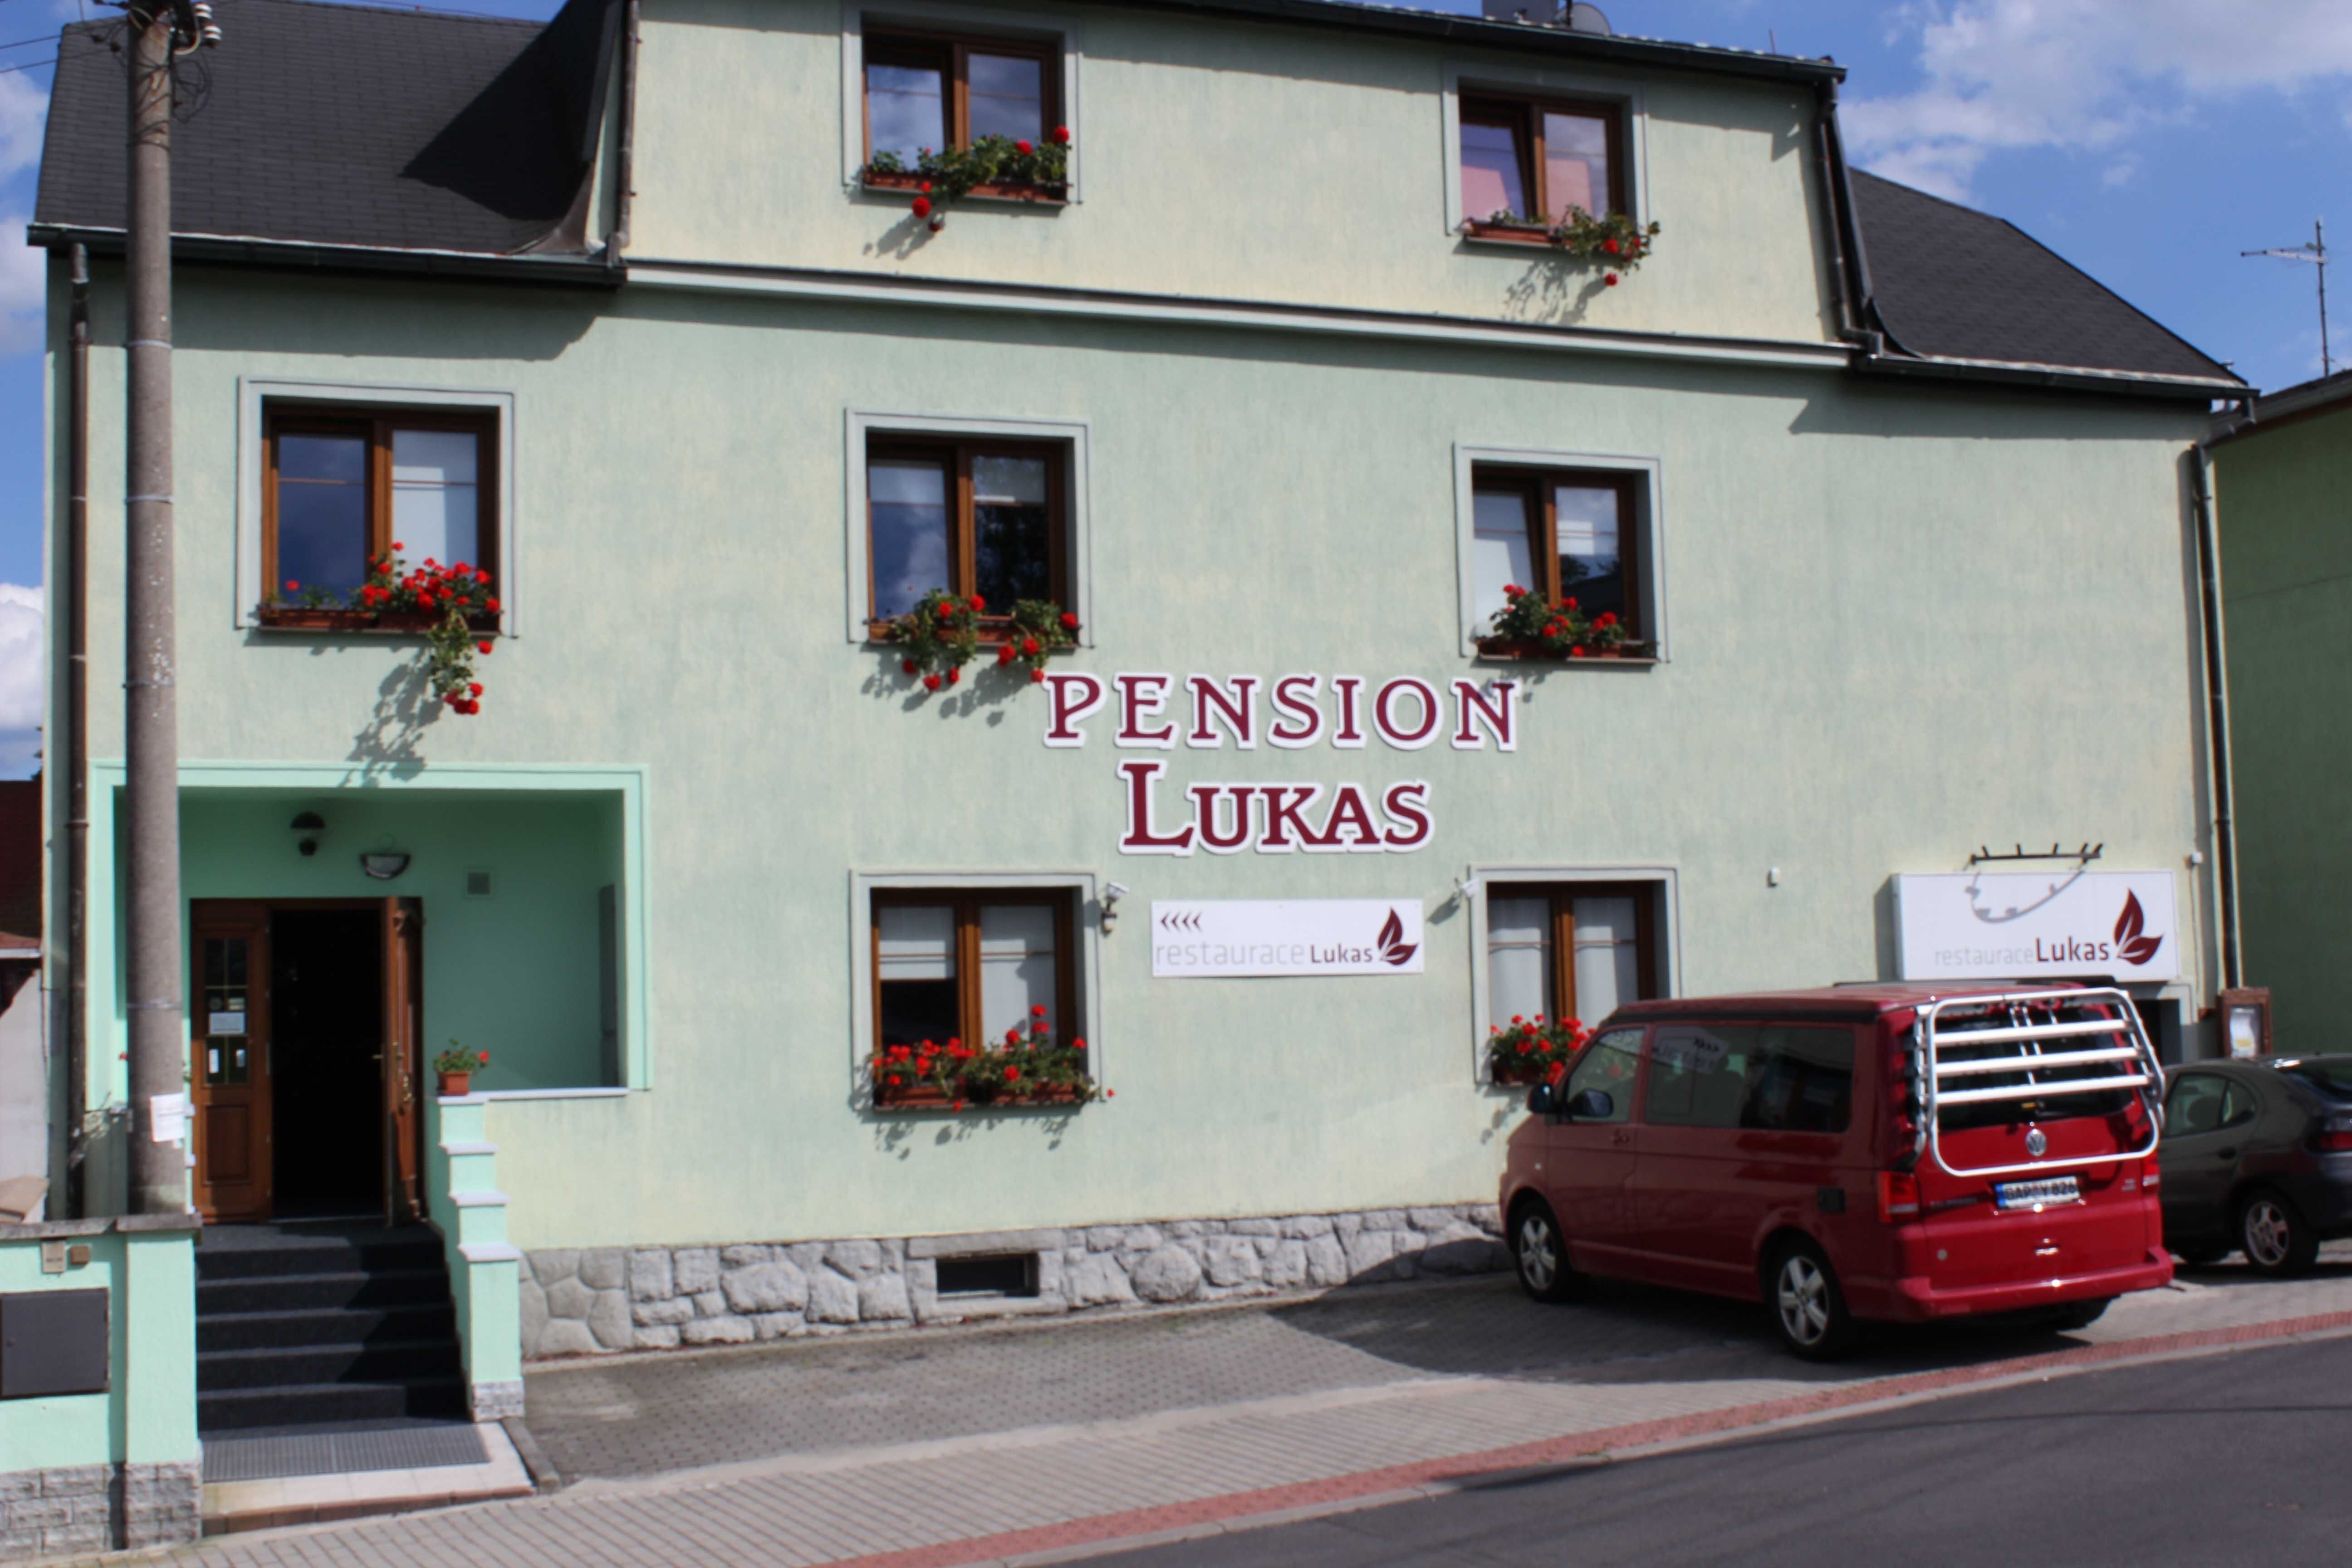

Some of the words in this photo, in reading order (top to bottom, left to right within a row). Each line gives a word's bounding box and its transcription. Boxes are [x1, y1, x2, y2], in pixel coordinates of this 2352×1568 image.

[1044, 672, 1519, 750] PENSION
[1119, 760, 1432, 853] LUKAS
[1156, 941, 1305, 966] restaurace
[1310, 943, 1373, 964] Lukas
[1935, 946, 2034, 966] restaurace
[2035, 936, 2109, 962] Lukas
